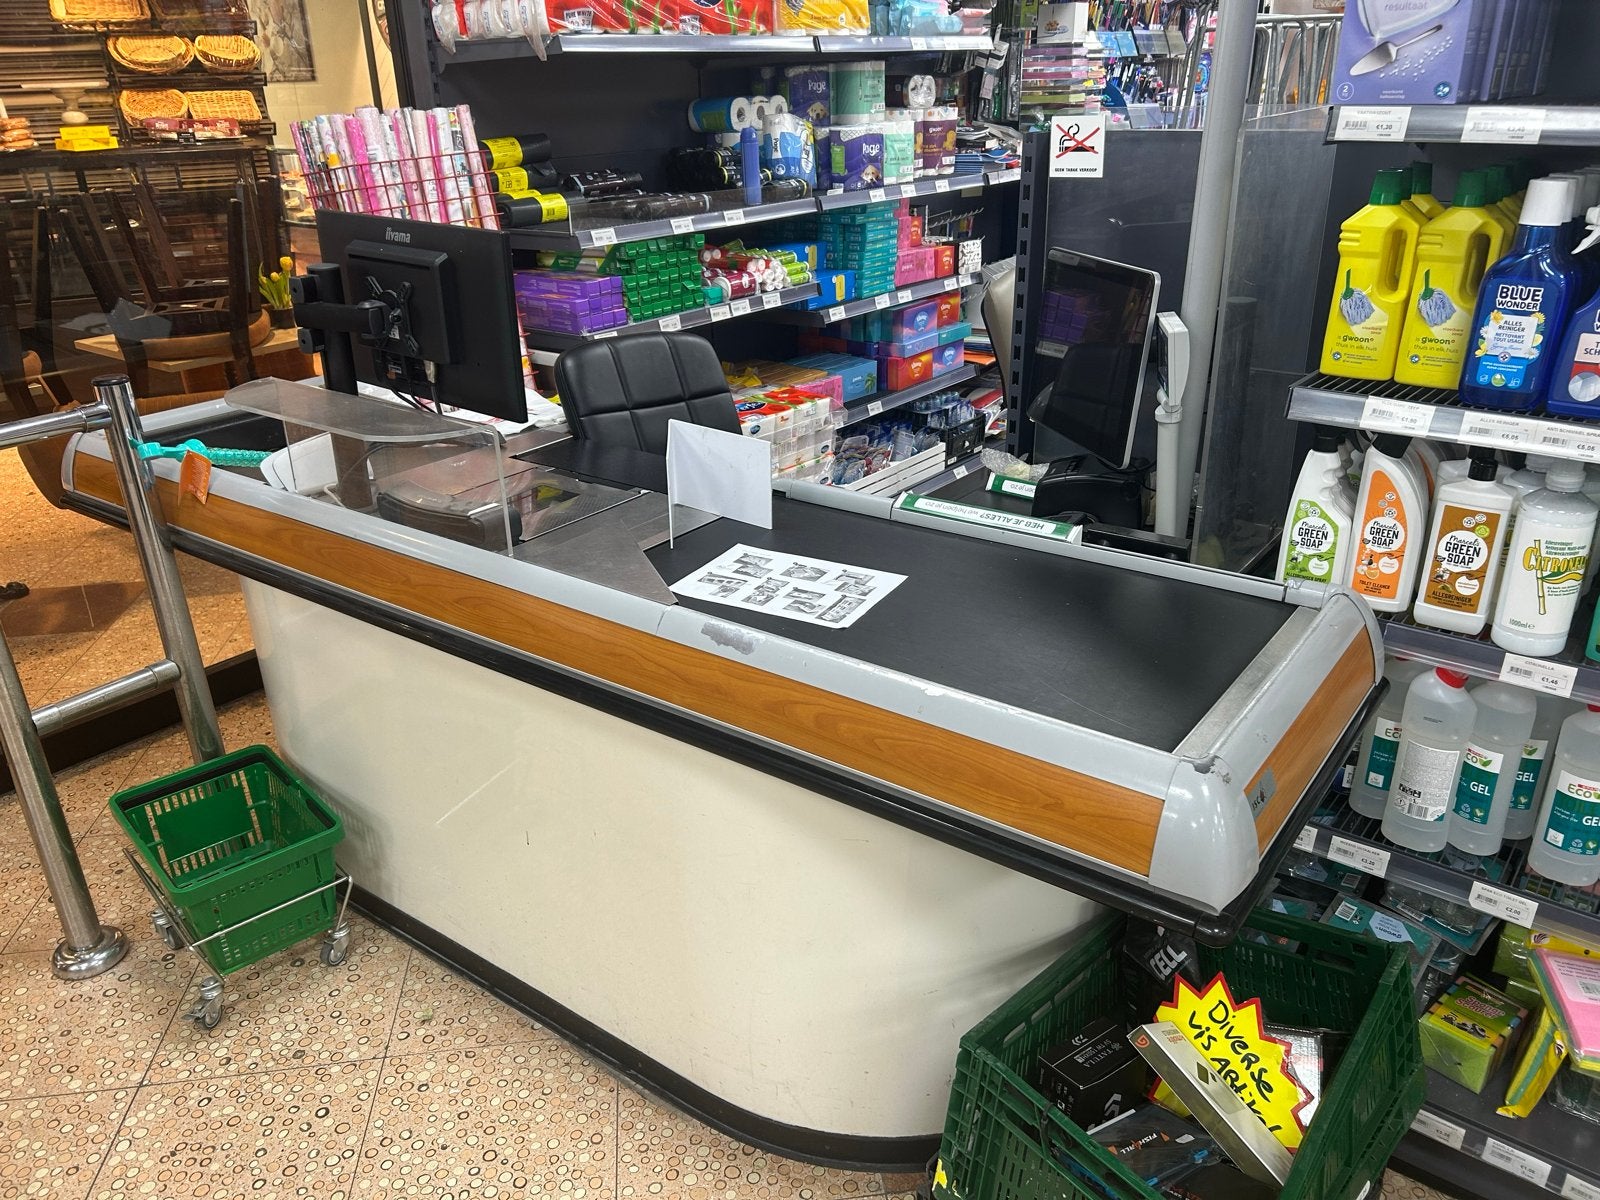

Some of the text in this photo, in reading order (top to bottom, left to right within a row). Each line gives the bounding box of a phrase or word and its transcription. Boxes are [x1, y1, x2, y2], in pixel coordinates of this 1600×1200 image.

[1384, 2, 1428, 11] resultaat
[808, 79, 827, 93] Page
[862, 143, 880, 156] Page
[385, 226, 411, 244] iiyama
[1498, 285, 1543, 302] BLUE
[1497, 300, 1540, 311] WONDER
[1342, 334, 1370, 343] gwoon
[1421, 336, 1451, 345] gwoon
[1495, 332, 1525, 340] NETTOYANT
[943, 505, 966, 515] helpen
[980, 513, 1013, 523] ALLES?
[1024, 522, 1045, 530] HEB
[1298, 527, 1329, 541] GREEN
[1369, 526, 1400, 540] GREEN
[1300, 538, 1323, 549] SOAP
[1371, 536, 1394, 547] SOAP
[1444, 541, 1482, 557] GREEN
[1446, 554, 1475, 567] SOAP
[1525, 660, 1555, 671] CITRONELLA
[1541, 677, 1559, 685] €1,45
[1515, 771, 1535, 783] GEL
[1469, 781, 1491, 796] GEL
[1567, 783, 1593, 799] ECO
[1505, 906, 1521, 916] €2,00
[1149, 945, 1188, 981] CELL
